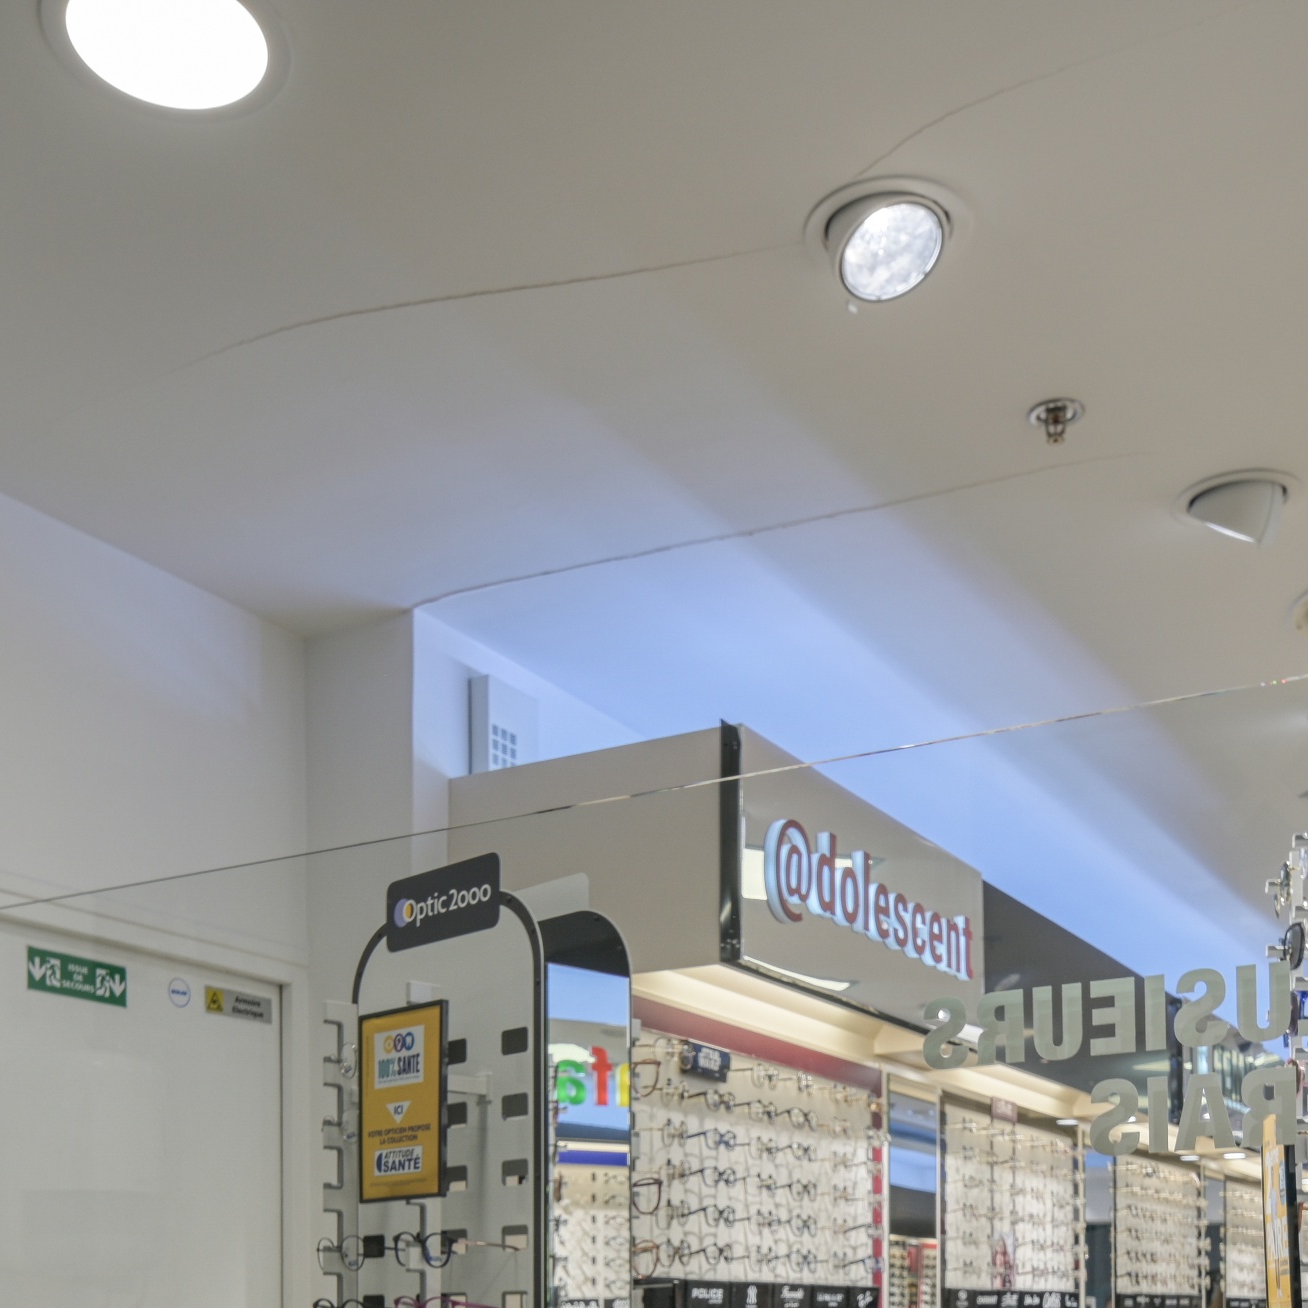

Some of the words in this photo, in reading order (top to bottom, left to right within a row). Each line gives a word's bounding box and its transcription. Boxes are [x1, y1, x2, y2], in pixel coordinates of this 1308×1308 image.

[764, 818, 974, 981] @dolescent
[61, 980, 95, 993] SECOURS
[393, 1104, 404, 1117] ICI
[367, 1130, 384, 1139] VOTRE
[384, 1126, 408, 1137] OPTICIEN
[408, 1122, 432, 1134] PROPOSE
[387, 1134, 419, 1144] COLLECTION
[384, 1147, 415, 1160] ATTITUDE
[383, 1154, 420, 1173] SANTÉ
